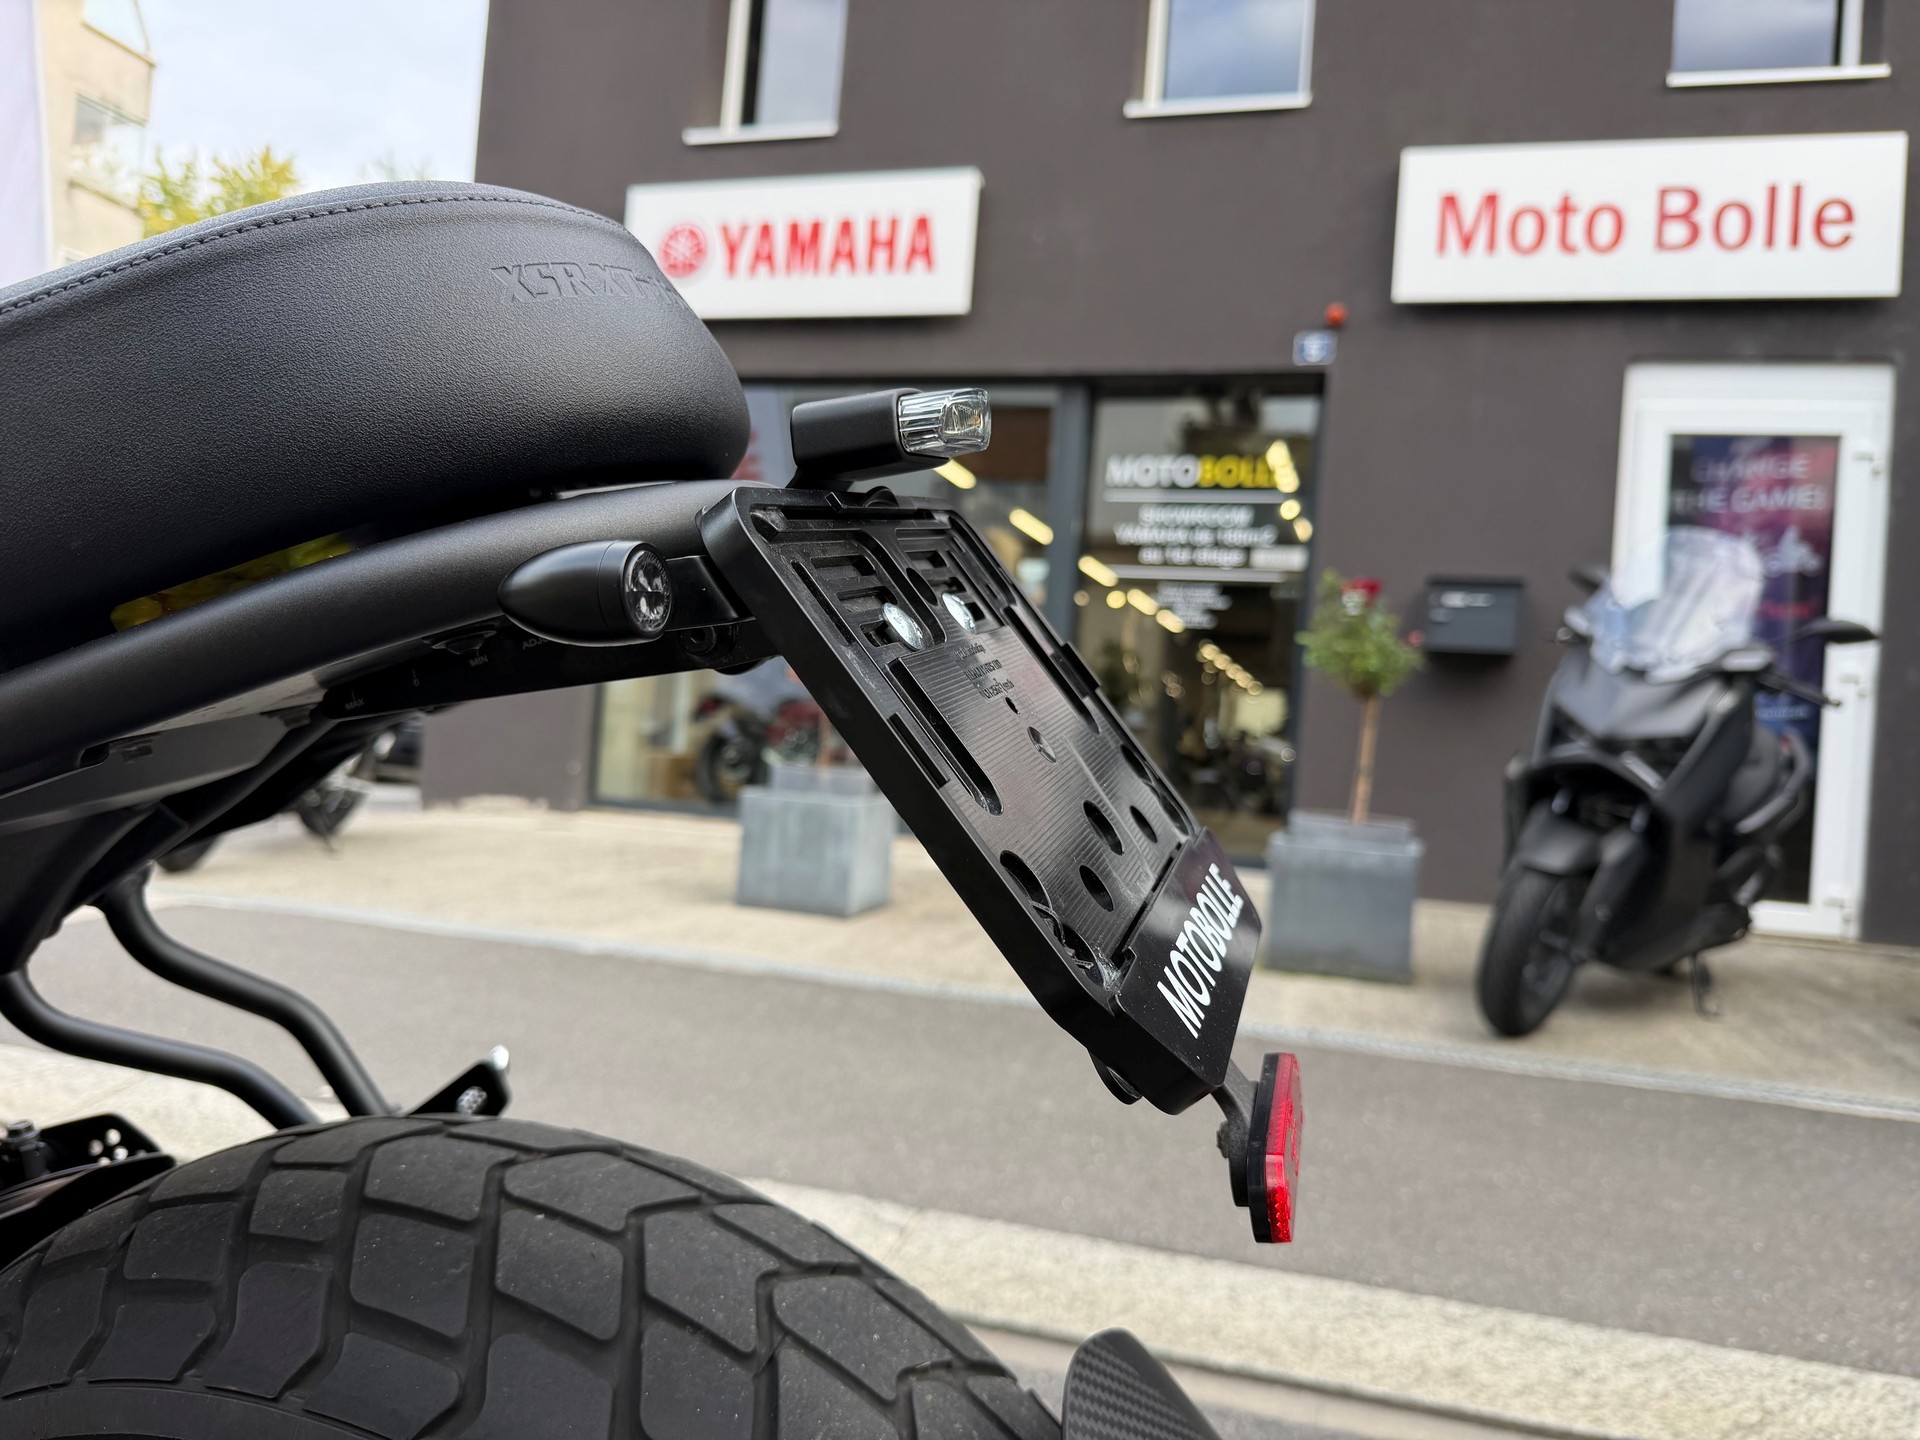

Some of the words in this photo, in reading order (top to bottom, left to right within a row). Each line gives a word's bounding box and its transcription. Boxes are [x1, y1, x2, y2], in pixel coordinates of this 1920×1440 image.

[1436, 190, 1625, 257] Moto
[1653, 182, 1856, 253] Bolle
[721, 214, 936, 278] YAMAHA
[491, 262, 595, 300] XSR
[1105, 454, 1297, 489] MOTOBOLL
[470, 654, 488, 667] MIN
[345, 698, 365, 711] MAX
[1156, 862, 1245, 1040] MOTOBOLLE
